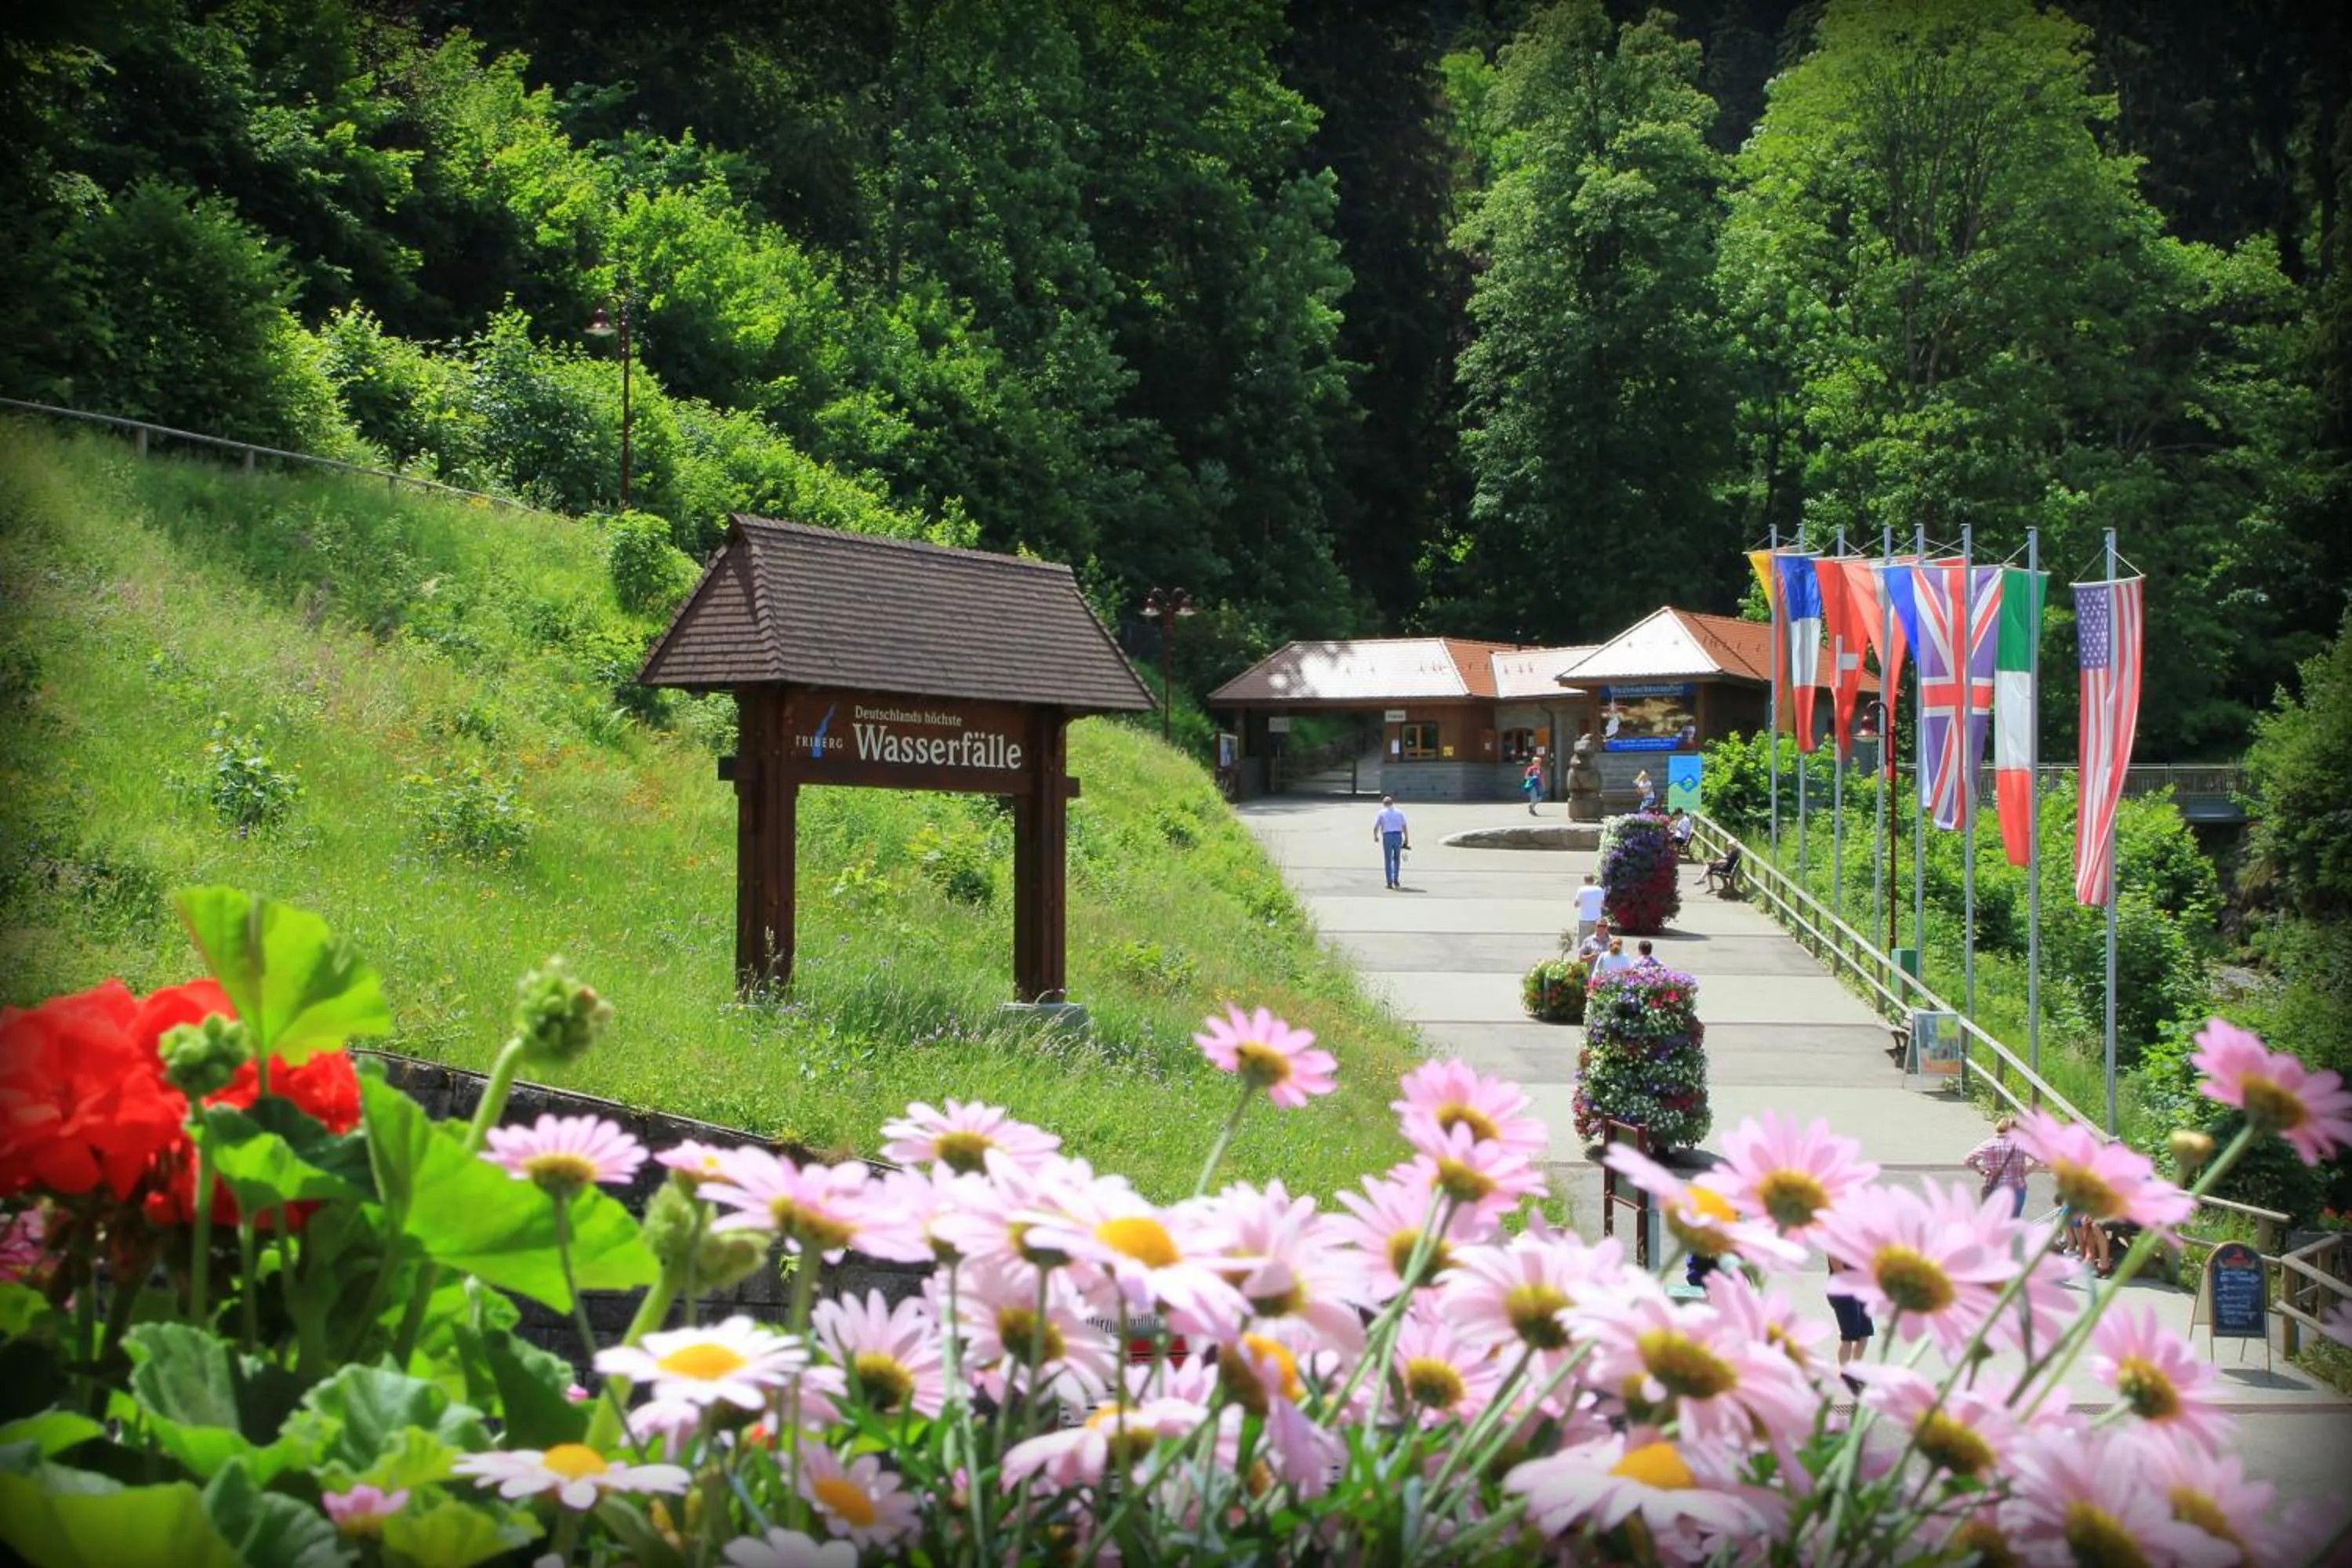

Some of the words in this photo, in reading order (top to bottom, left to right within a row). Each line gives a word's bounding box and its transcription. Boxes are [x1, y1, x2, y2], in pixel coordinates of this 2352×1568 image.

[855, 705, 922, 723] Deutschlands
[924, 710, 963, 727] höchste
[796, 735, 844, 750] TRIBERG
[851, 722, 1022, 769] Wasserfälle
